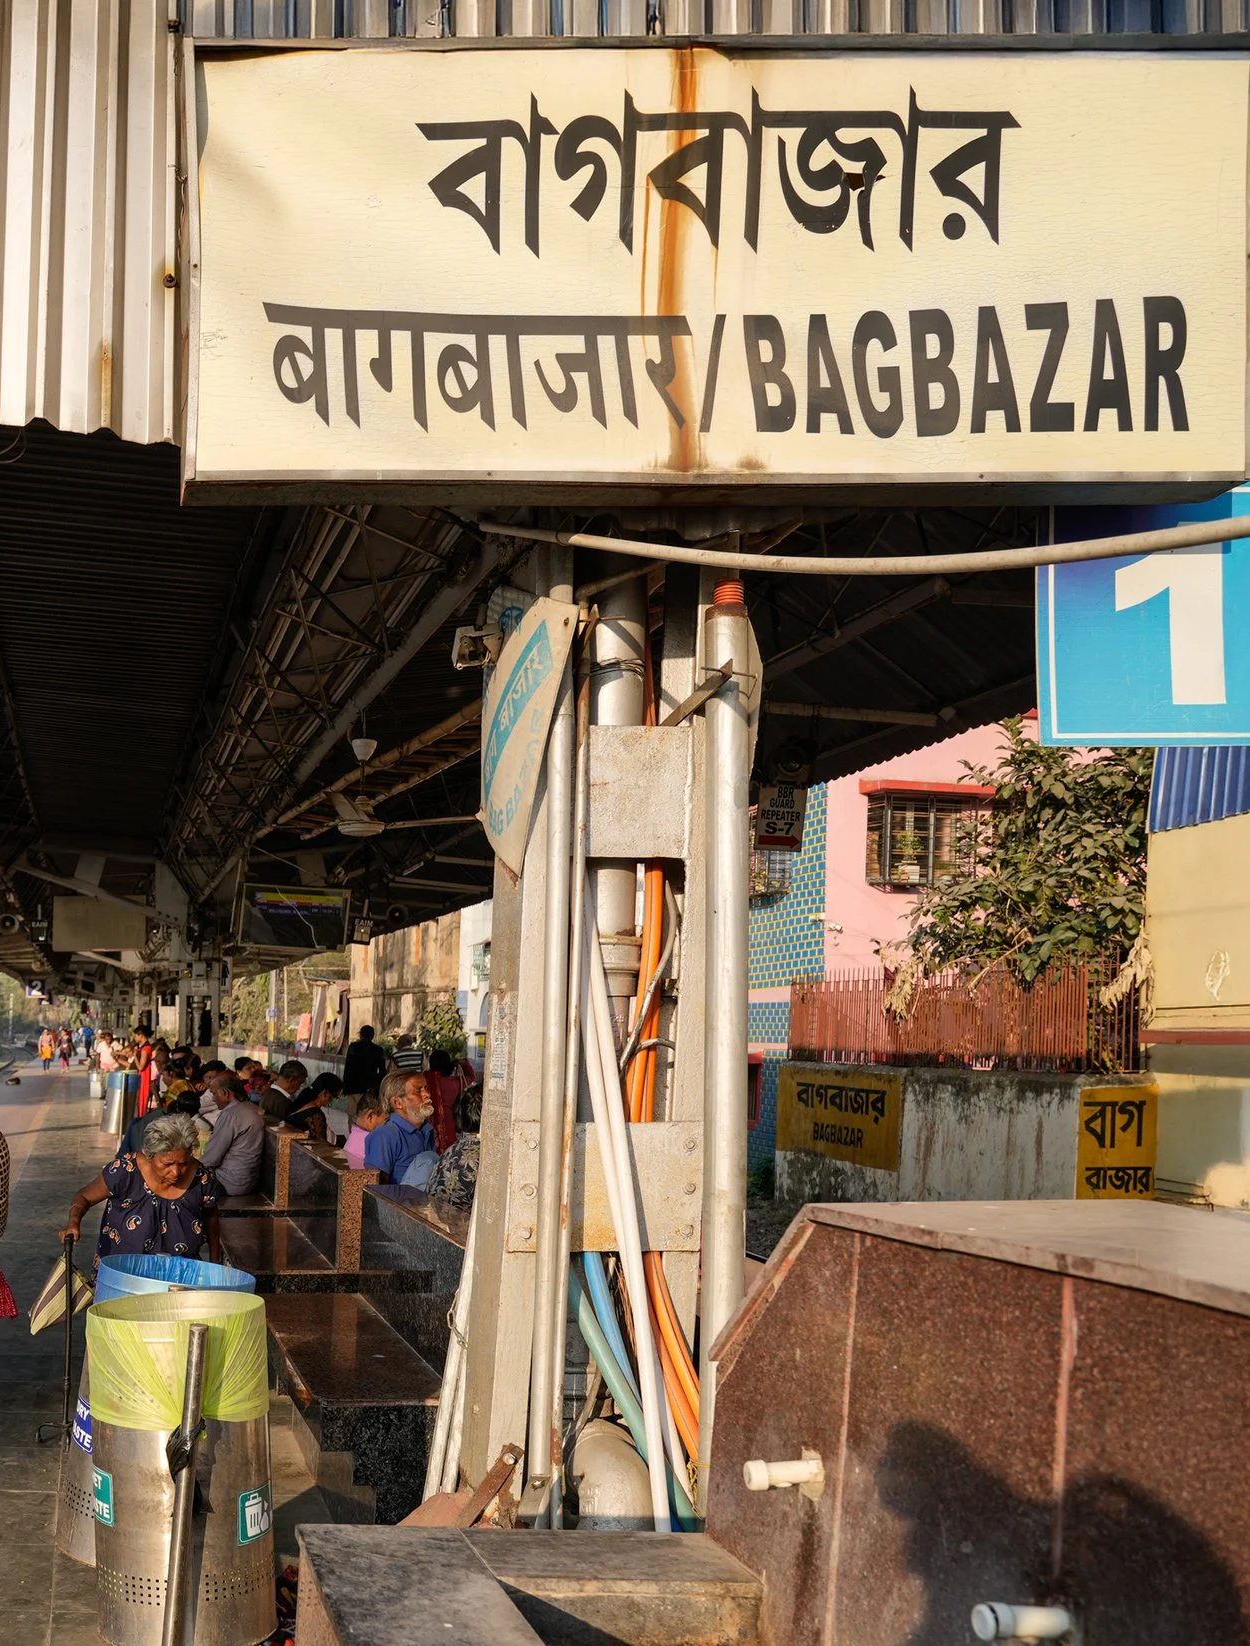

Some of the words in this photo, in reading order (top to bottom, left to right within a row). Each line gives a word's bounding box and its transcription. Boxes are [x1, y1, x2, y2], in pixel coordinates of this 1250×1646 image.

[416, 86, 1021, 256] বাগবাজার
[1115, 521, 1227, 705] 1
[770, 798, 795, 809] GUARD
[777, 786, 794, 799] BBR
[761, 809, 801, 821] REPEATER
[765, 821, 795, 835] S-7
[31, 980, 42, 995] 2
[796, 1081, 887, 1125] বাগবাজার
[813, 1121, 864, 1149] BAGBAZAR
[1083, 1099, 1146, 1149] বাগ
[1085, 1166, 1152, 1194] বাজার
[92, 1471, 102, 1490] ET
